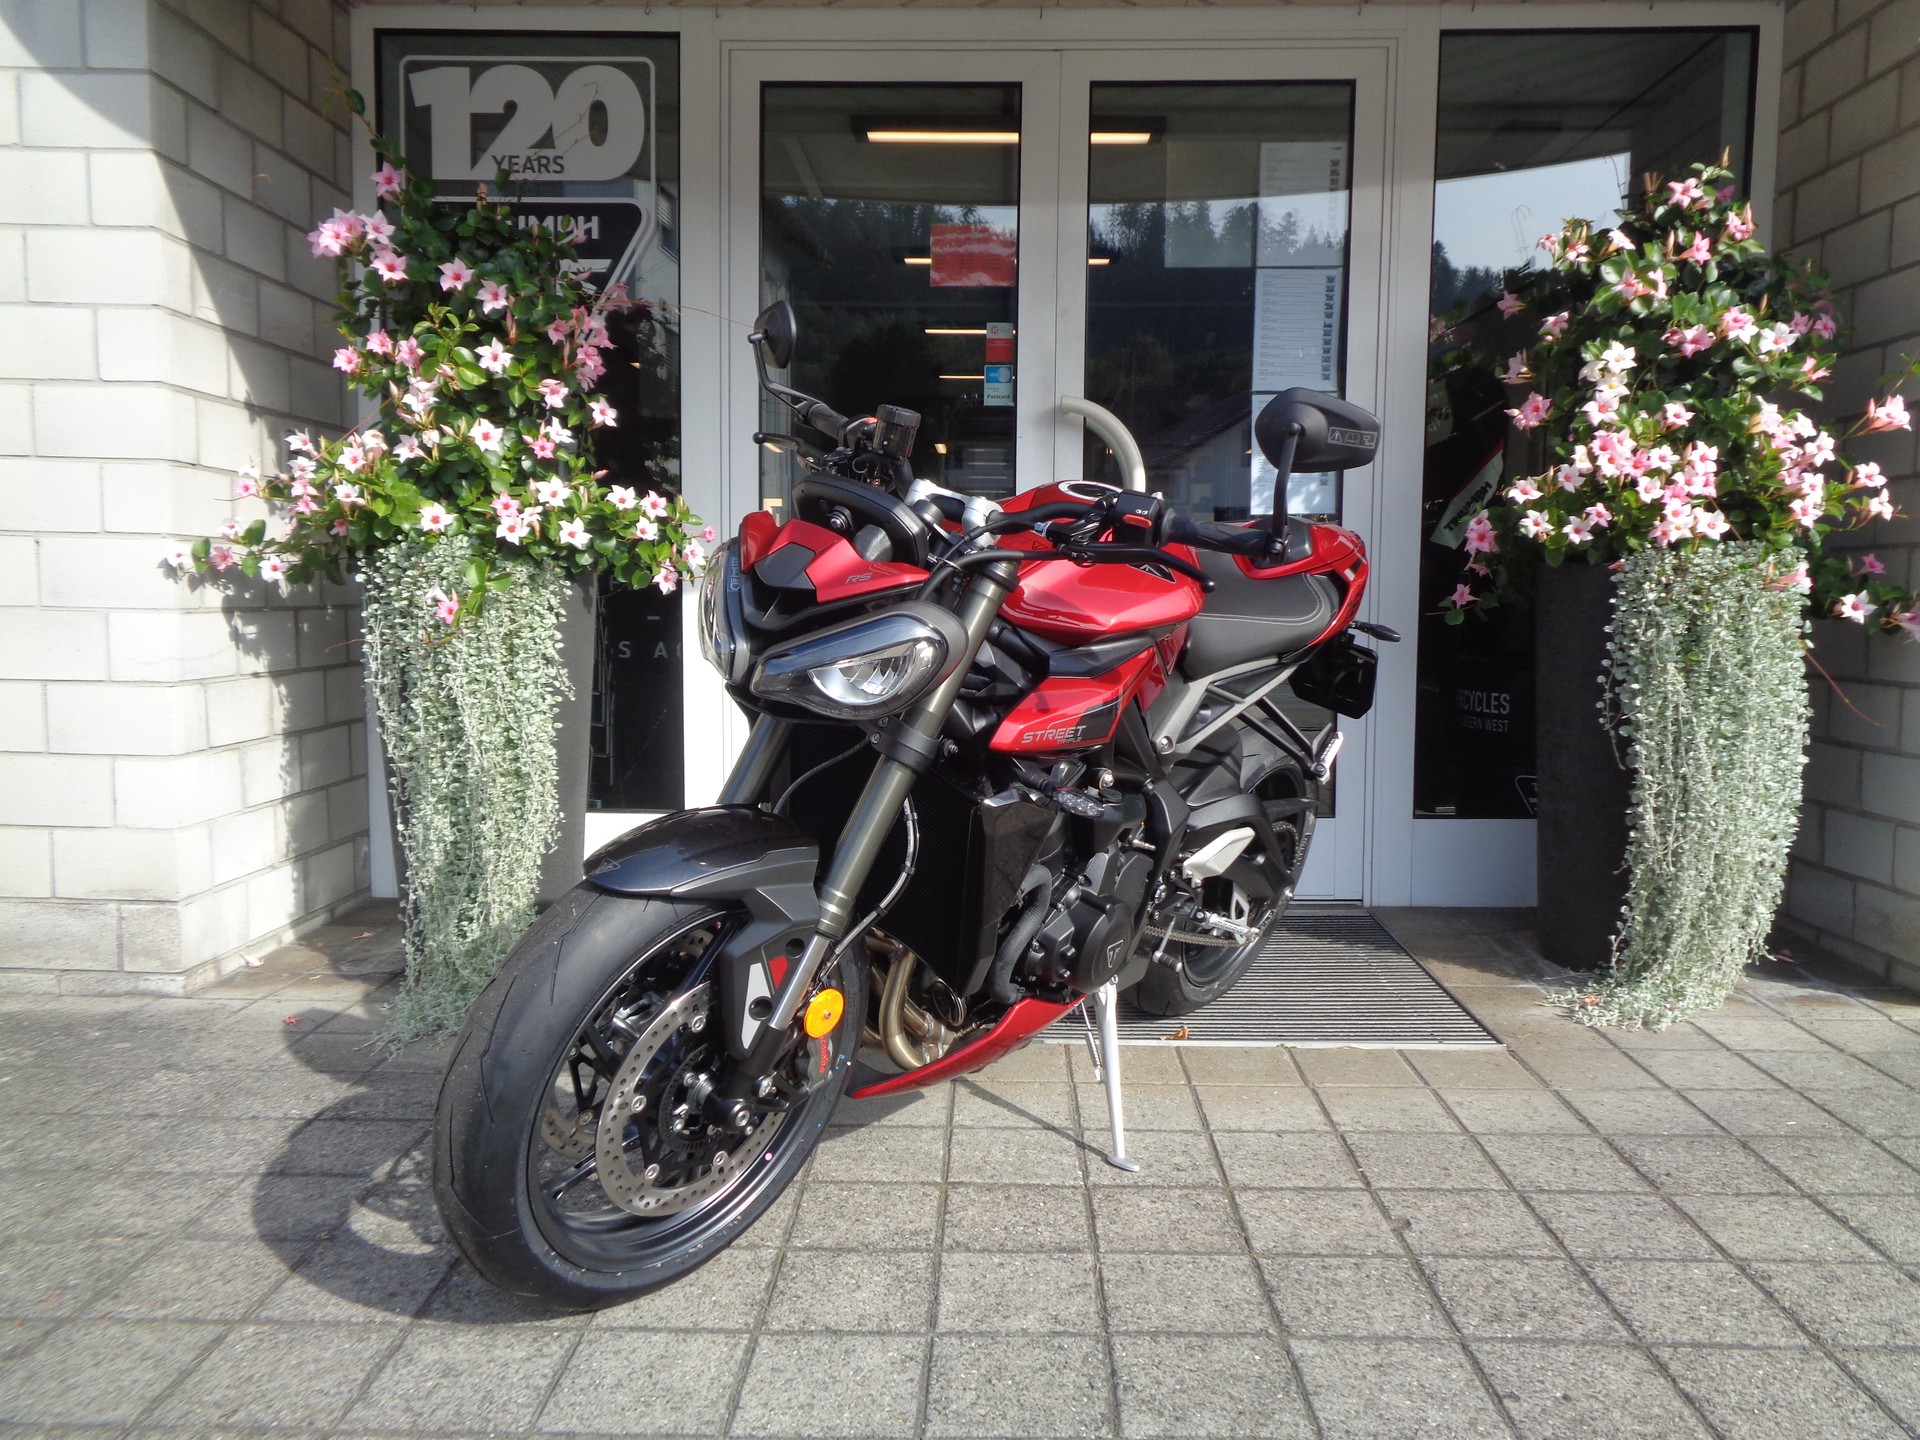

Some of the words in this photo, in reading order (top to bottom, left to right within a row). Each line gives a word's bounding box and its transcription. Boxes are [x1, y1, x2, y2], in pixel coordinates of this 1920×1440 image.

[409, 65, 645, 181] 120
[491, 154, 565, 174] YEARS
[845, 573, 872, 584] RS
[1485, 718, 1509, 732] WEST
[1022, 725, 1086, 744] STREET
[1056, 737, 1082, 745] TRIPLE
